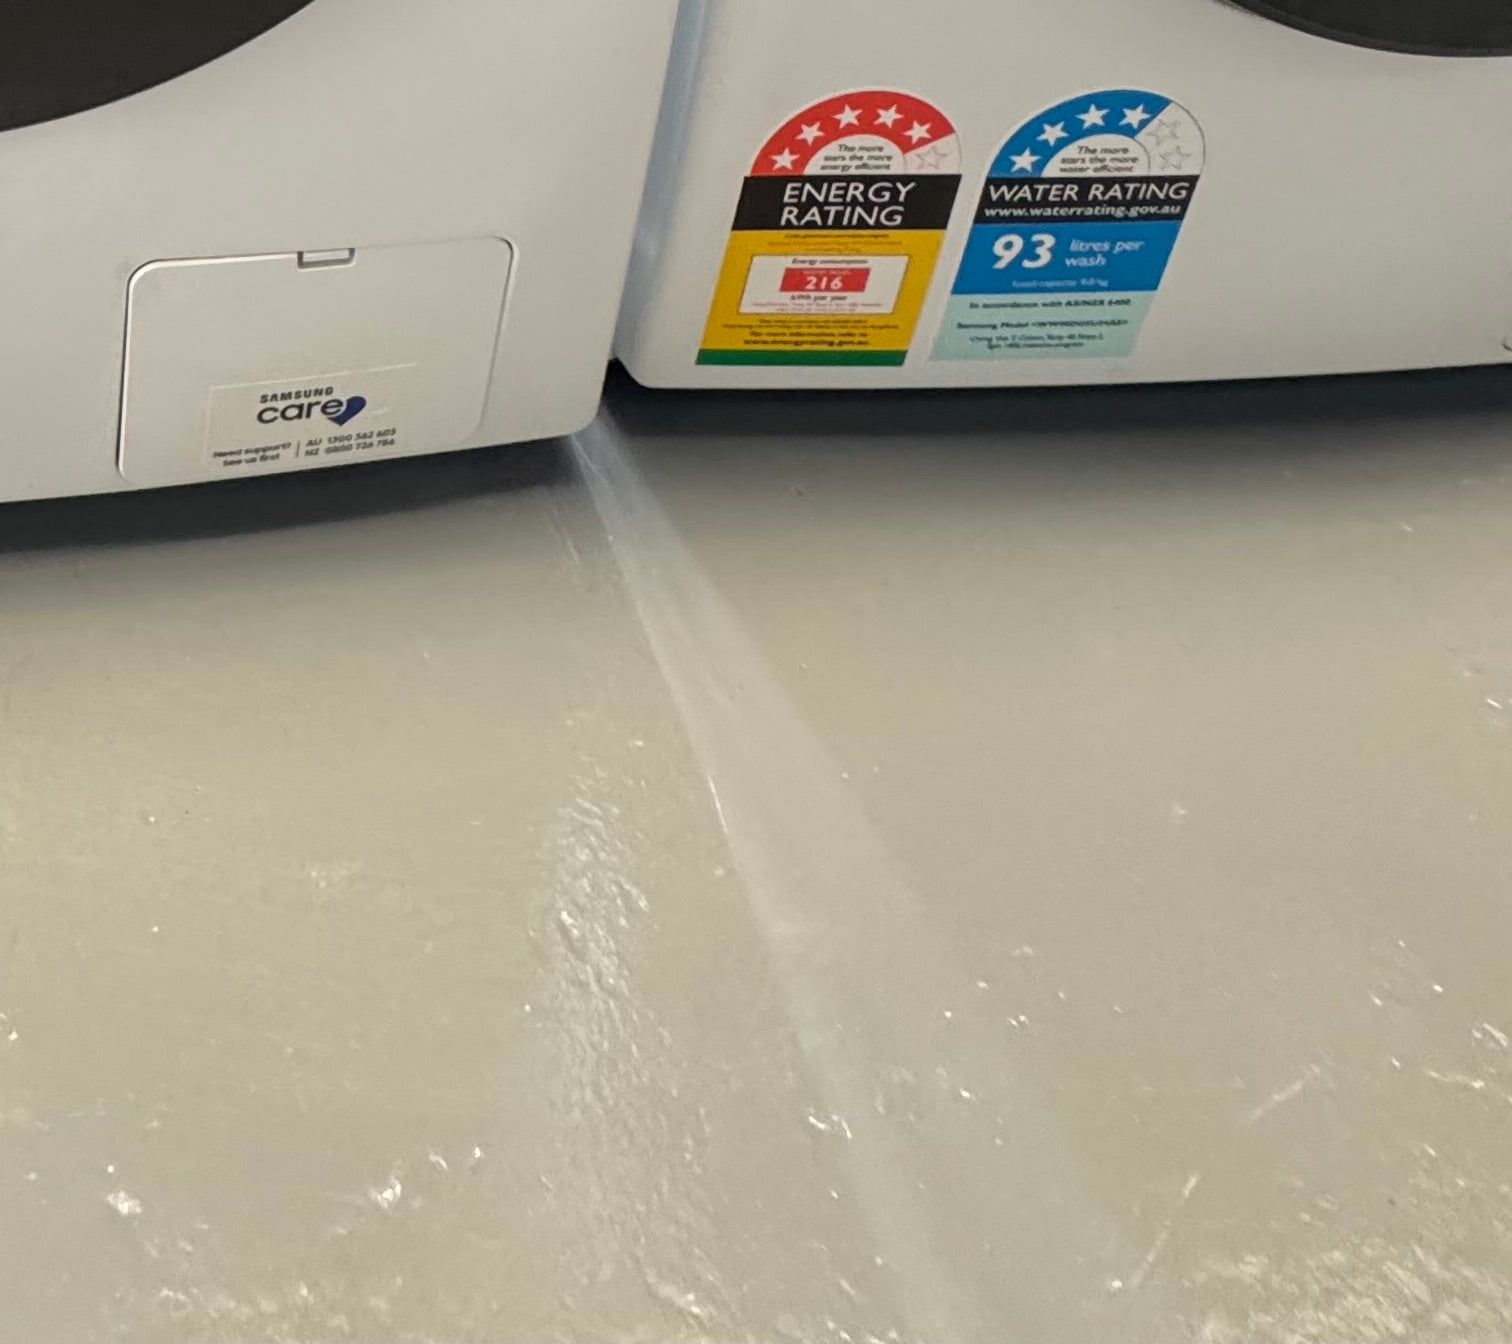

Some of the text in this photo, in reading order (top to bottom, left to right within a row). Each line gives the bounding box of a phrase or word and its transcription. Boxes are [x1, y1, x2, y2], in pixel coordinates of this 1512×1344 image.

[783, 181, 916, 203] ENERGY
[989, 182, 1190, 202] WATER RATING
[780, 206, 905, 226] RATING
[984, 204, 1180, 218] www.waterrating.gov.au
[991, 232, 1056, 270] 93
[1069, 239, 1145, 255] litres per
[1065, 255, 1106, 267] wash
[804, 276, 843, 290] 216
[259, 385, 334, 404] SAMSUNG
[256, 397, 345, 425] care
